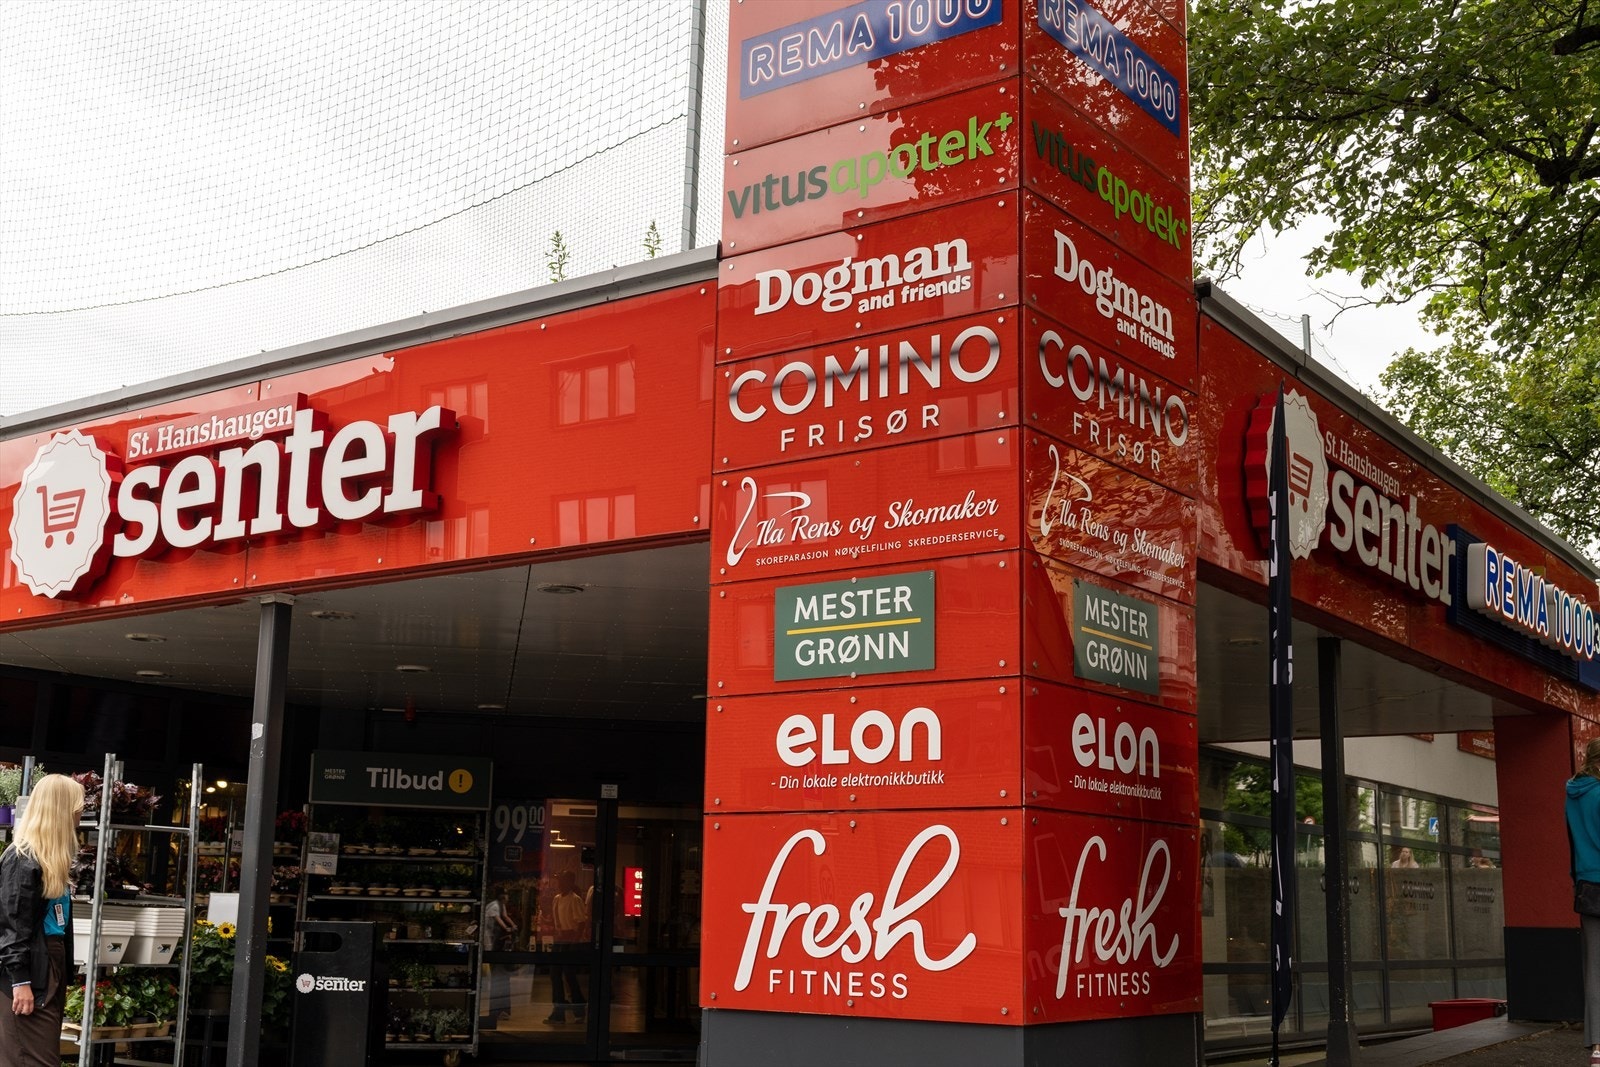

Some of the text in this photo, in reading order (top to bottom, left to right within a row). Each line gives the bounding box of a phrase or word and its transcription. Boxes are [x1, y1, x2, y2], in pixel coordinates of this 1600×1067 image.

[750, 13, 874, 84] REMA
[1124, 48, 1176, 120] 1000
[754, 238, 972, 316] Dogman
[858, 274, 972, 314] and friends
[1054, 229, 1175, 342] Dogman
[1116, 317, 1175, 360] and friends
[728, 325, 1001, 423] COMINO
[1038, 330, 1188, 447] COMINO
[129, 403, 293, 459] St. Hanshaugen
[780, 404, 941, 453] FRISØR
[1072, 412, 1161, 473] FRISØR
[113, 405, 441, 558] senter
[1325, 430, 1400, 498] St. Hanshaugen
[790, 514, 843, 543] Rens
[849, 513, 877, 540] og
[884, 489, 999, 530] Skomaker
[1080, 507, 1110, 541] Rens
[1113, 530, 1129, 555] og
[1131, 528, 1186, 568] Skomaker
[1330, 469, 1456, 606] senter
[756, 528, 999, 566] SKOREPARASJON NØKKELFILING SKREDDERSERVICE
[793, 585, 914, 623] MESTER
[1084, 594, 1150, 639] MESTER
[1485, 545, 1595, 661] REMA 1000
[794, 631, 910, 667] GRØNN
[1085, 640, 1149, 682] GRØNN
[366, 767, 443, 791] Tilbud
[779, 776, 800, 789] Din
[803, 774, 838, 788] lokale
[841, 770, 945, 787] elektronikkbutikk
[1074, 775, 1086, 789] Din
[1088, 776, 1108, 792] lokale
[733, 825, 977, 993] fresh
[1055, 836, 1179, 999] fresh
[315, 977, 366, 992] senter
[769, 970, 908, 999] FITNESS
[1077, 972, 1151, 998] FITNESS
